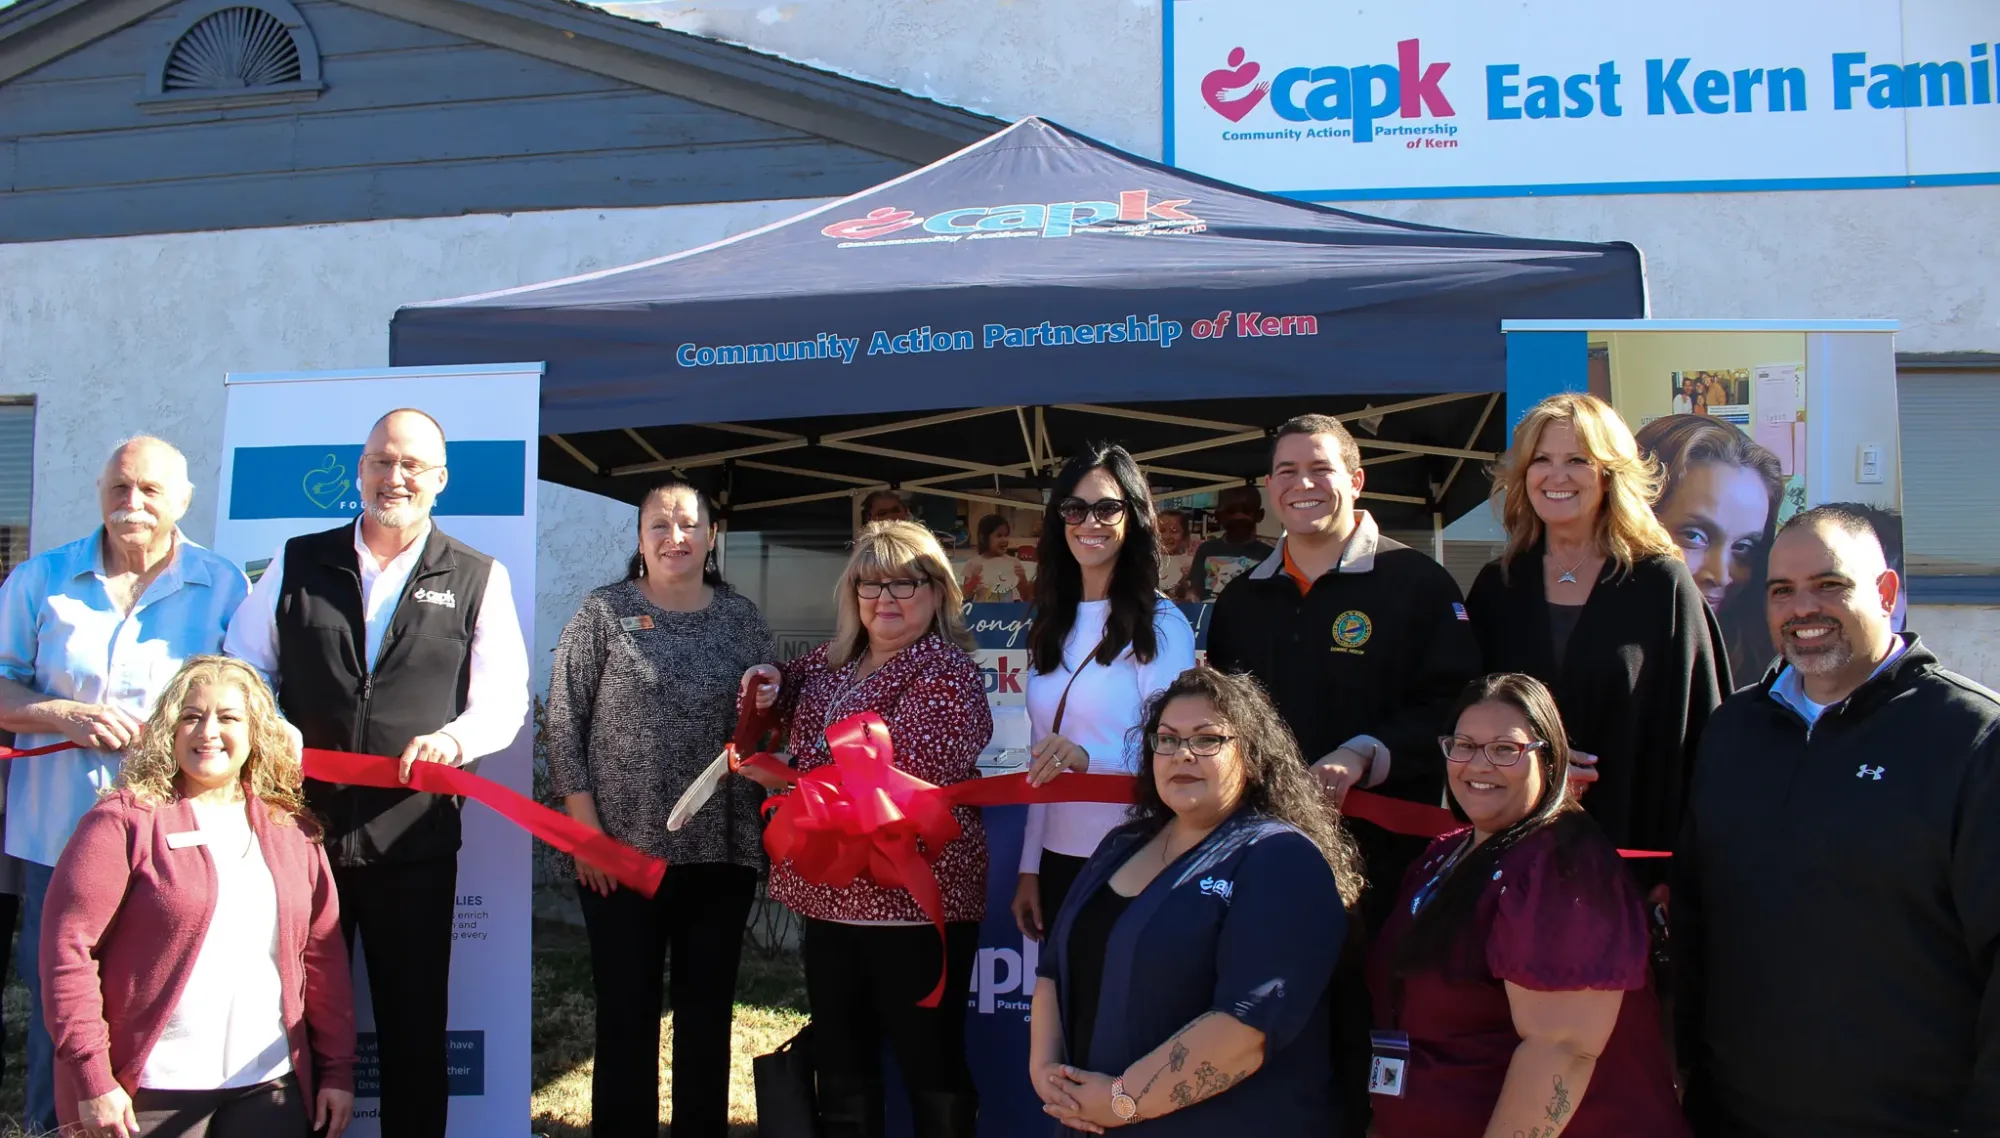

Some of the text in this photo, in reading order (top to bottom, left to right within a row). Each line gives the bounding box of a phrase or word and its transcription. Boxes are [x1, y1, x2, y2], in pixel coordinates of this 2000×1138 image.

[1270, 38, 1456, 143] capk
[1485, 60, 1622, 120] East
[1645, 57, 1807, 116] Kern
[1222, 123, 1458, 141] Community Action Partnership
[1406, 138, 1458, 149] of Kern
[923, 190, 1198, 238] capk
[676, 310, 1318, 367] Community Action Partnership of Kern
[456, 896, 482, 905] LIES
[458, 911, 489, 919] enrich
[458, 921, 477, 929] and
[460, 932, 487, 940] every
[450, 1040, 474, 1049] have
[447, 1066, 471, 1075] their
